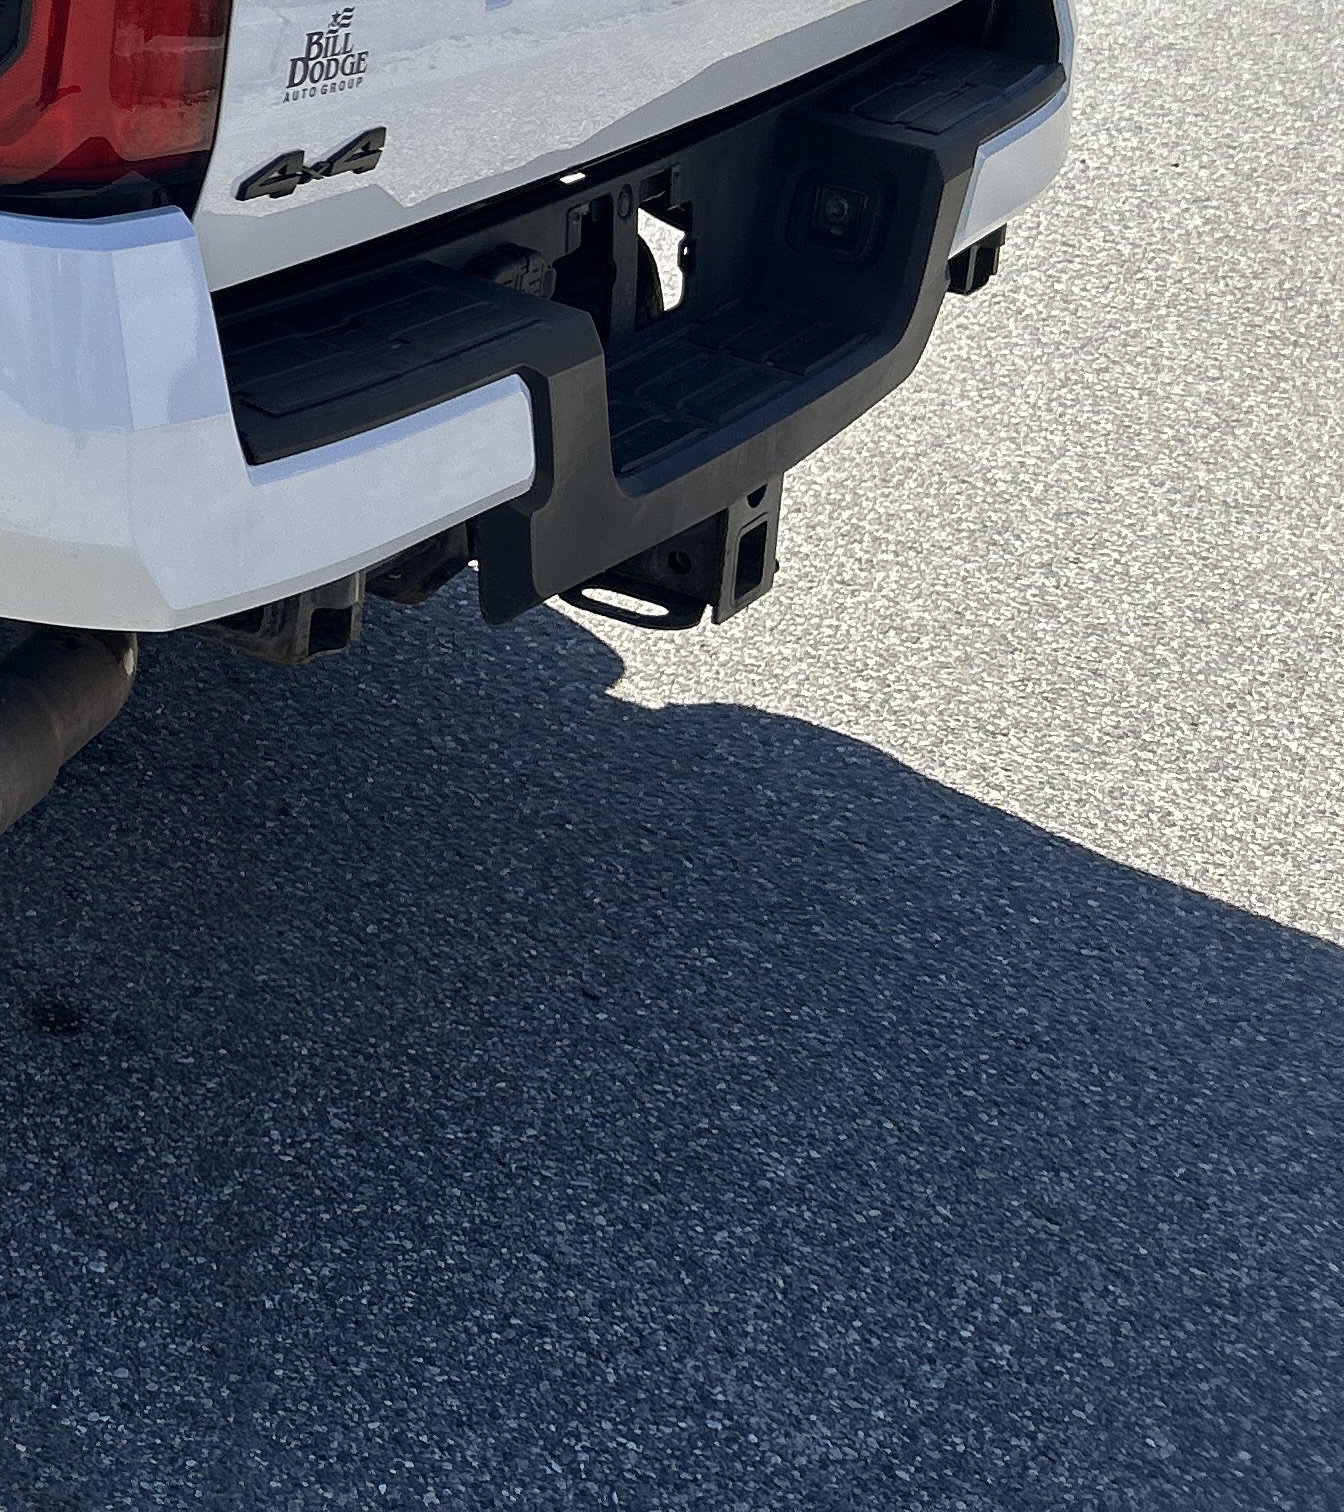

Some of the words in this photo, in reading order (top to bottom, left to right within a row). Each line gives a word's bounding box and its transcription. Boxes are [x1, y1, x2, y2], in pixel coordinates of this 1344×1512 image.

[305, 31, 354, 61] BILL
[286, 51, 369, 88] DODGE
[282, 87, 316, 103] AUTO
[321, 77, 363, 94] GROUP
